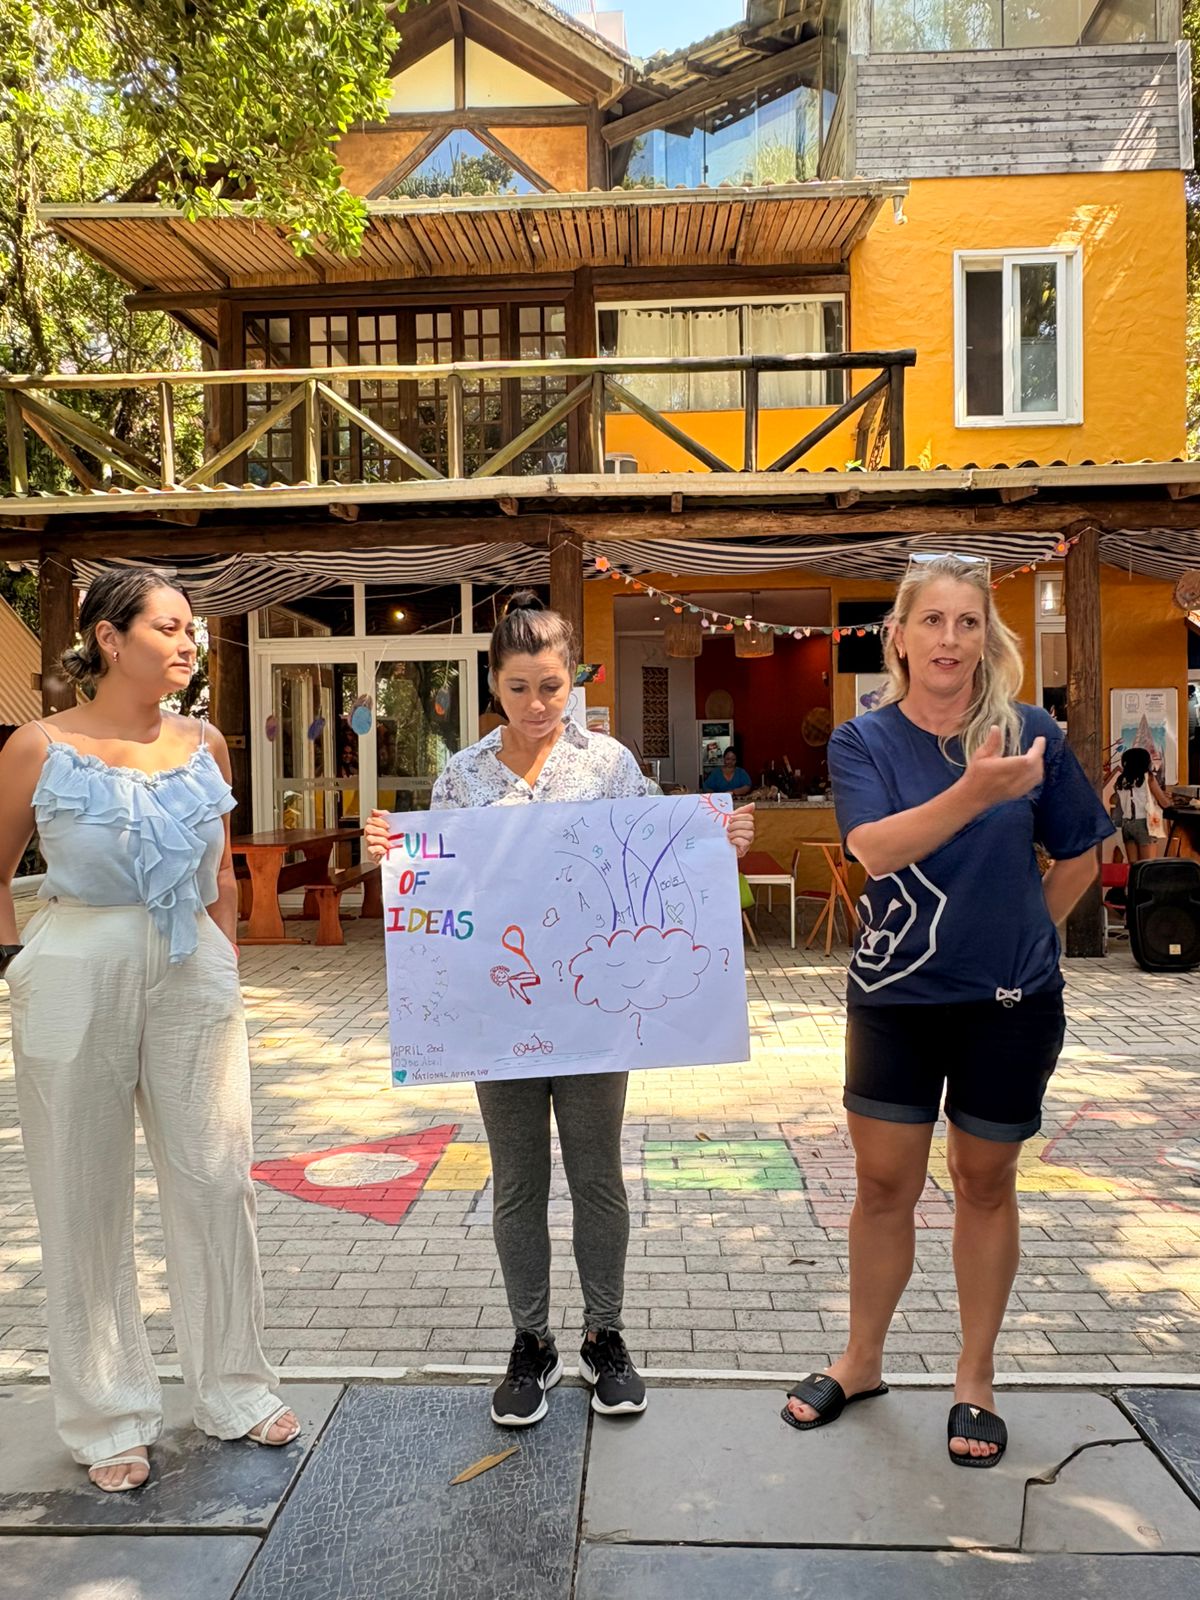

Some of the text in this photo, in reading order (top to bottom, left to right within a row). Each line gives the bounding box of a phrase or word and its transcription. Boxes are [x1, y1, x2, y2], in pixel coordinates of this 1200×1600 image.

[386, 832, 456, 861] FULL
[399, 870, 430, 895] OF
[386, 906, 474, 940] IDEAS
[392, 1044, 423, 1057] APRIL
[412, 1068, 448, 1080] NATIONAL
